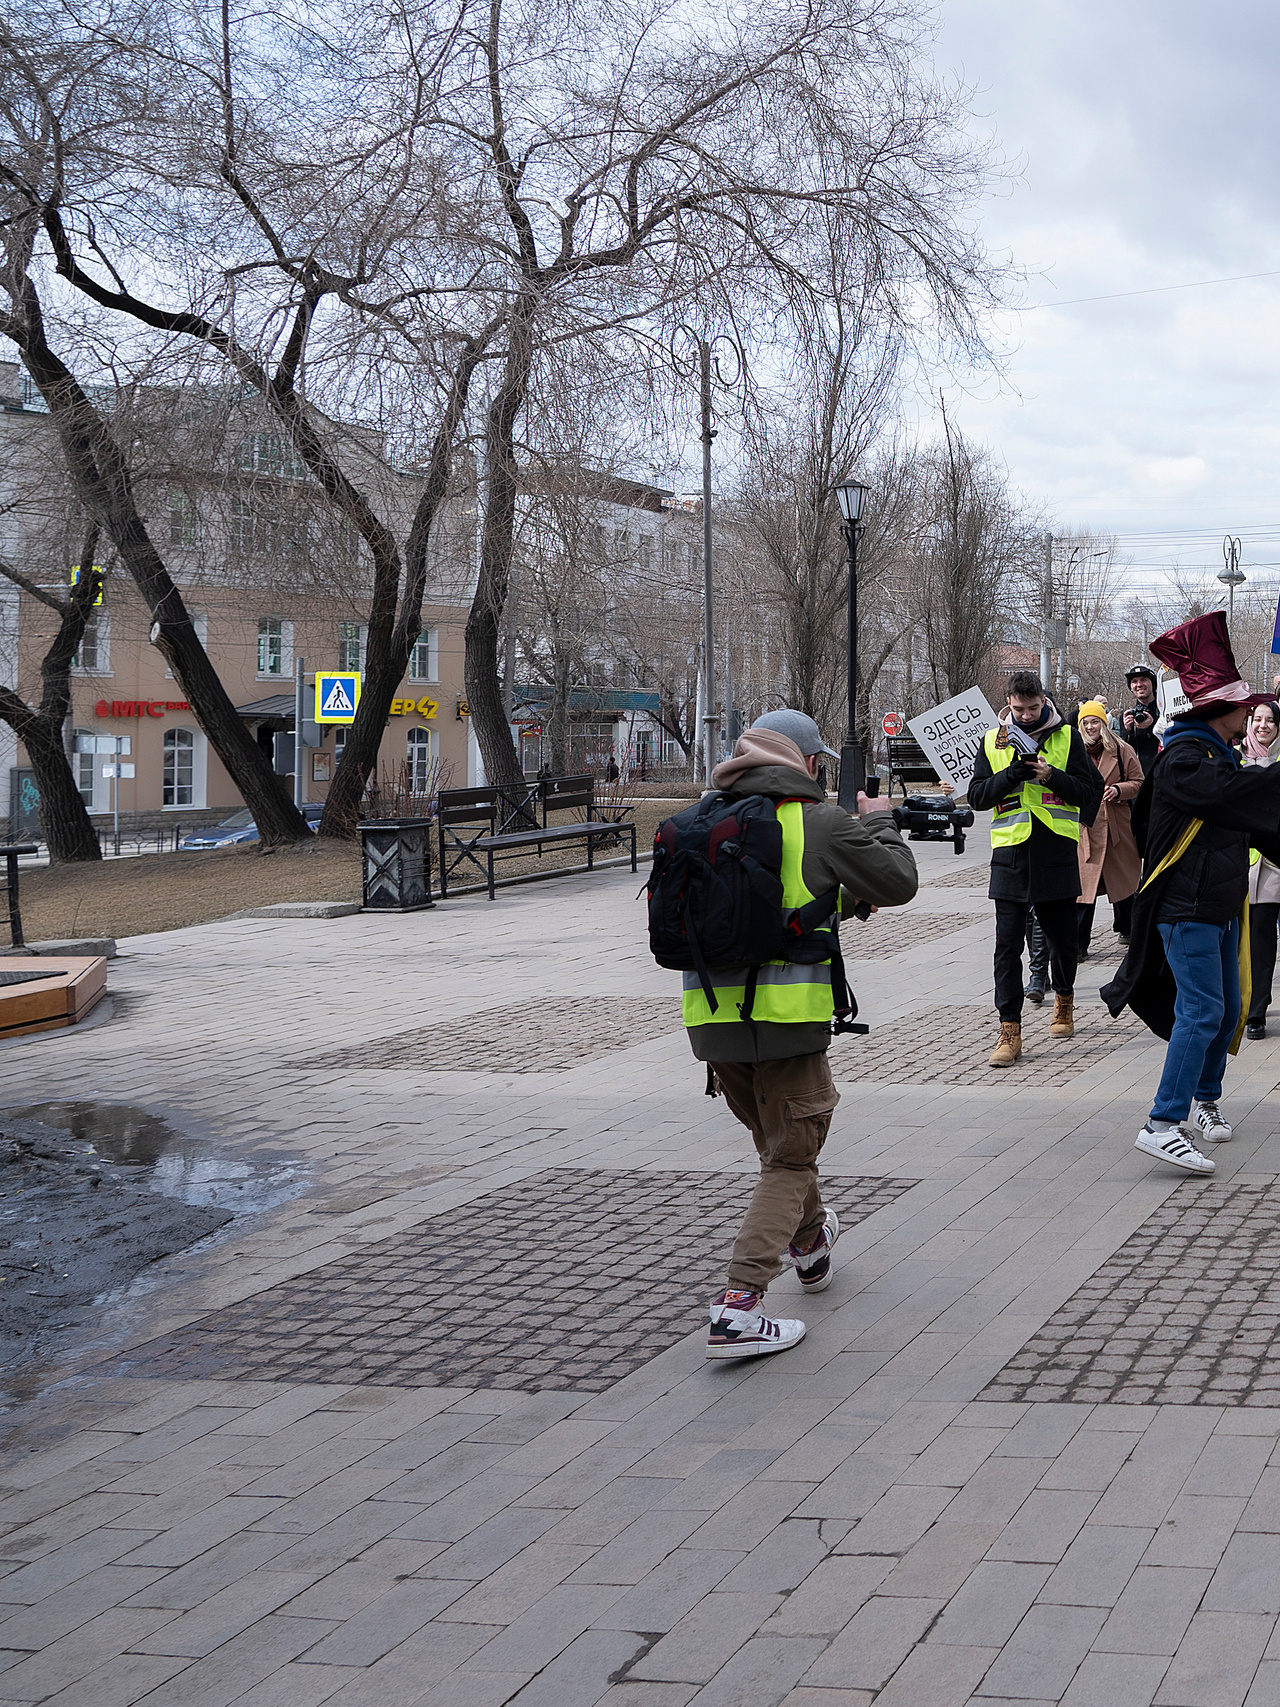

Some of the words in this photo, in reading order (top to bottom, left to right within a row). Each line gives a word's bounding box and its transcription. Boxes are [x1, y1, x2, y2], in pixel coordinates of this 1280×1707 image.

[112, 701, 165, 717] МТС
[166, 702, 191, 710] БАН
[389, 699, 416, 716] ЕР
[923, 705, 982, 741] ЗДЕСЬ
[933, 734, 965, 754] МОГЛА
[964, 721, 990, 738] БЫТЬ
[939, 736, 981, 772] ВАШ
[951, 764, 975, 783] РЕК
[927, 813, 949, 821] RONIN
